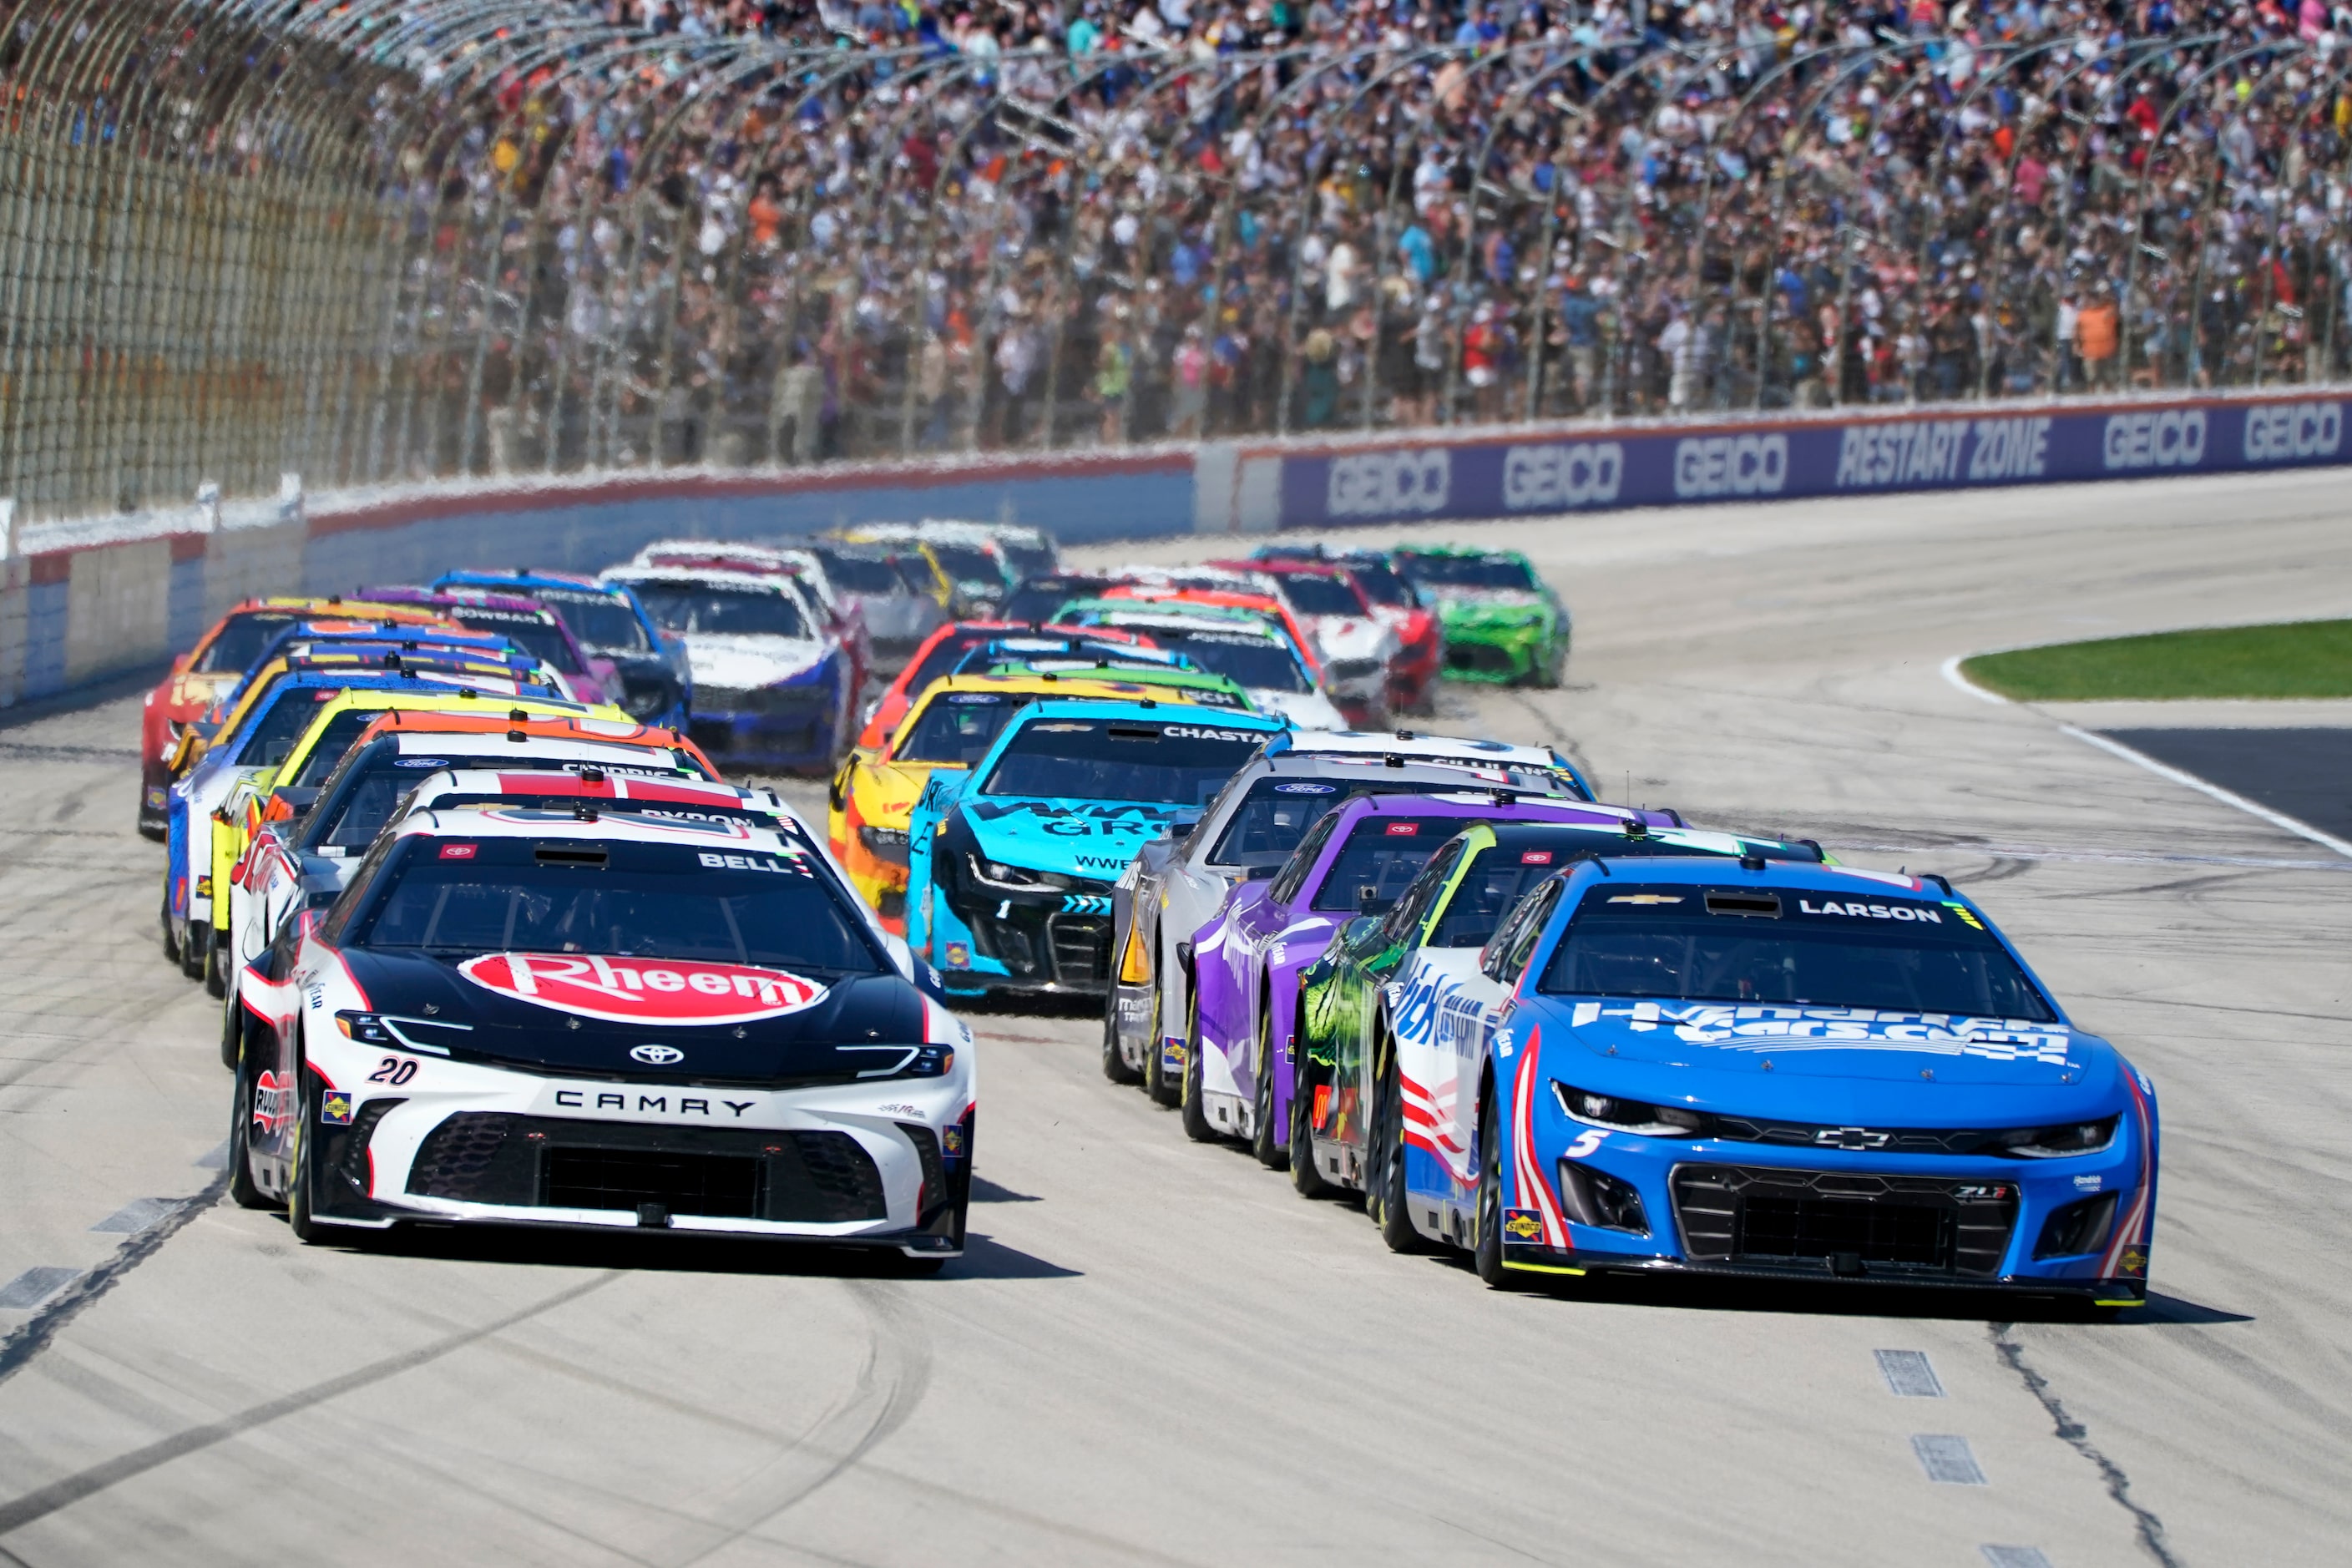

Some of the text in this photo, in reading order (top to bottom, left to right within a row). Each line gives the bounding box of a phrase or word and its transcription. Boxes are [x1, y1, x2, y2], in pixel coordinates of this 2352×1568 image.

[2103, 410, 2207, 469] GEICO
[2244, 403, 2341, 462] GEICO
[1674, 433, 1788, 498] GEICO
[1836, 417, 2051, 487] RESTART ZONE
[1328, 448, 1450, 517] GEICO
[1504, 442, 1622, 509] GEICO
[1163, 726, 1275, 744] CHASTA
[697, 852, 792, 874] BELL
[996, 899, 1011, 919] 1
[1799, 900, 1942, 924] LARSON
[506, 954, 803, 1004] Rheem
[365, 1056, 420, 1088] 20
[326, 1103, 350, 1114] SUNOCO
[555, 1090, 756, 1117] CAMRY
[1565, 1129, 1611, 1159] 5
[1507, 1222, 1541, 1233] SUNOCO
